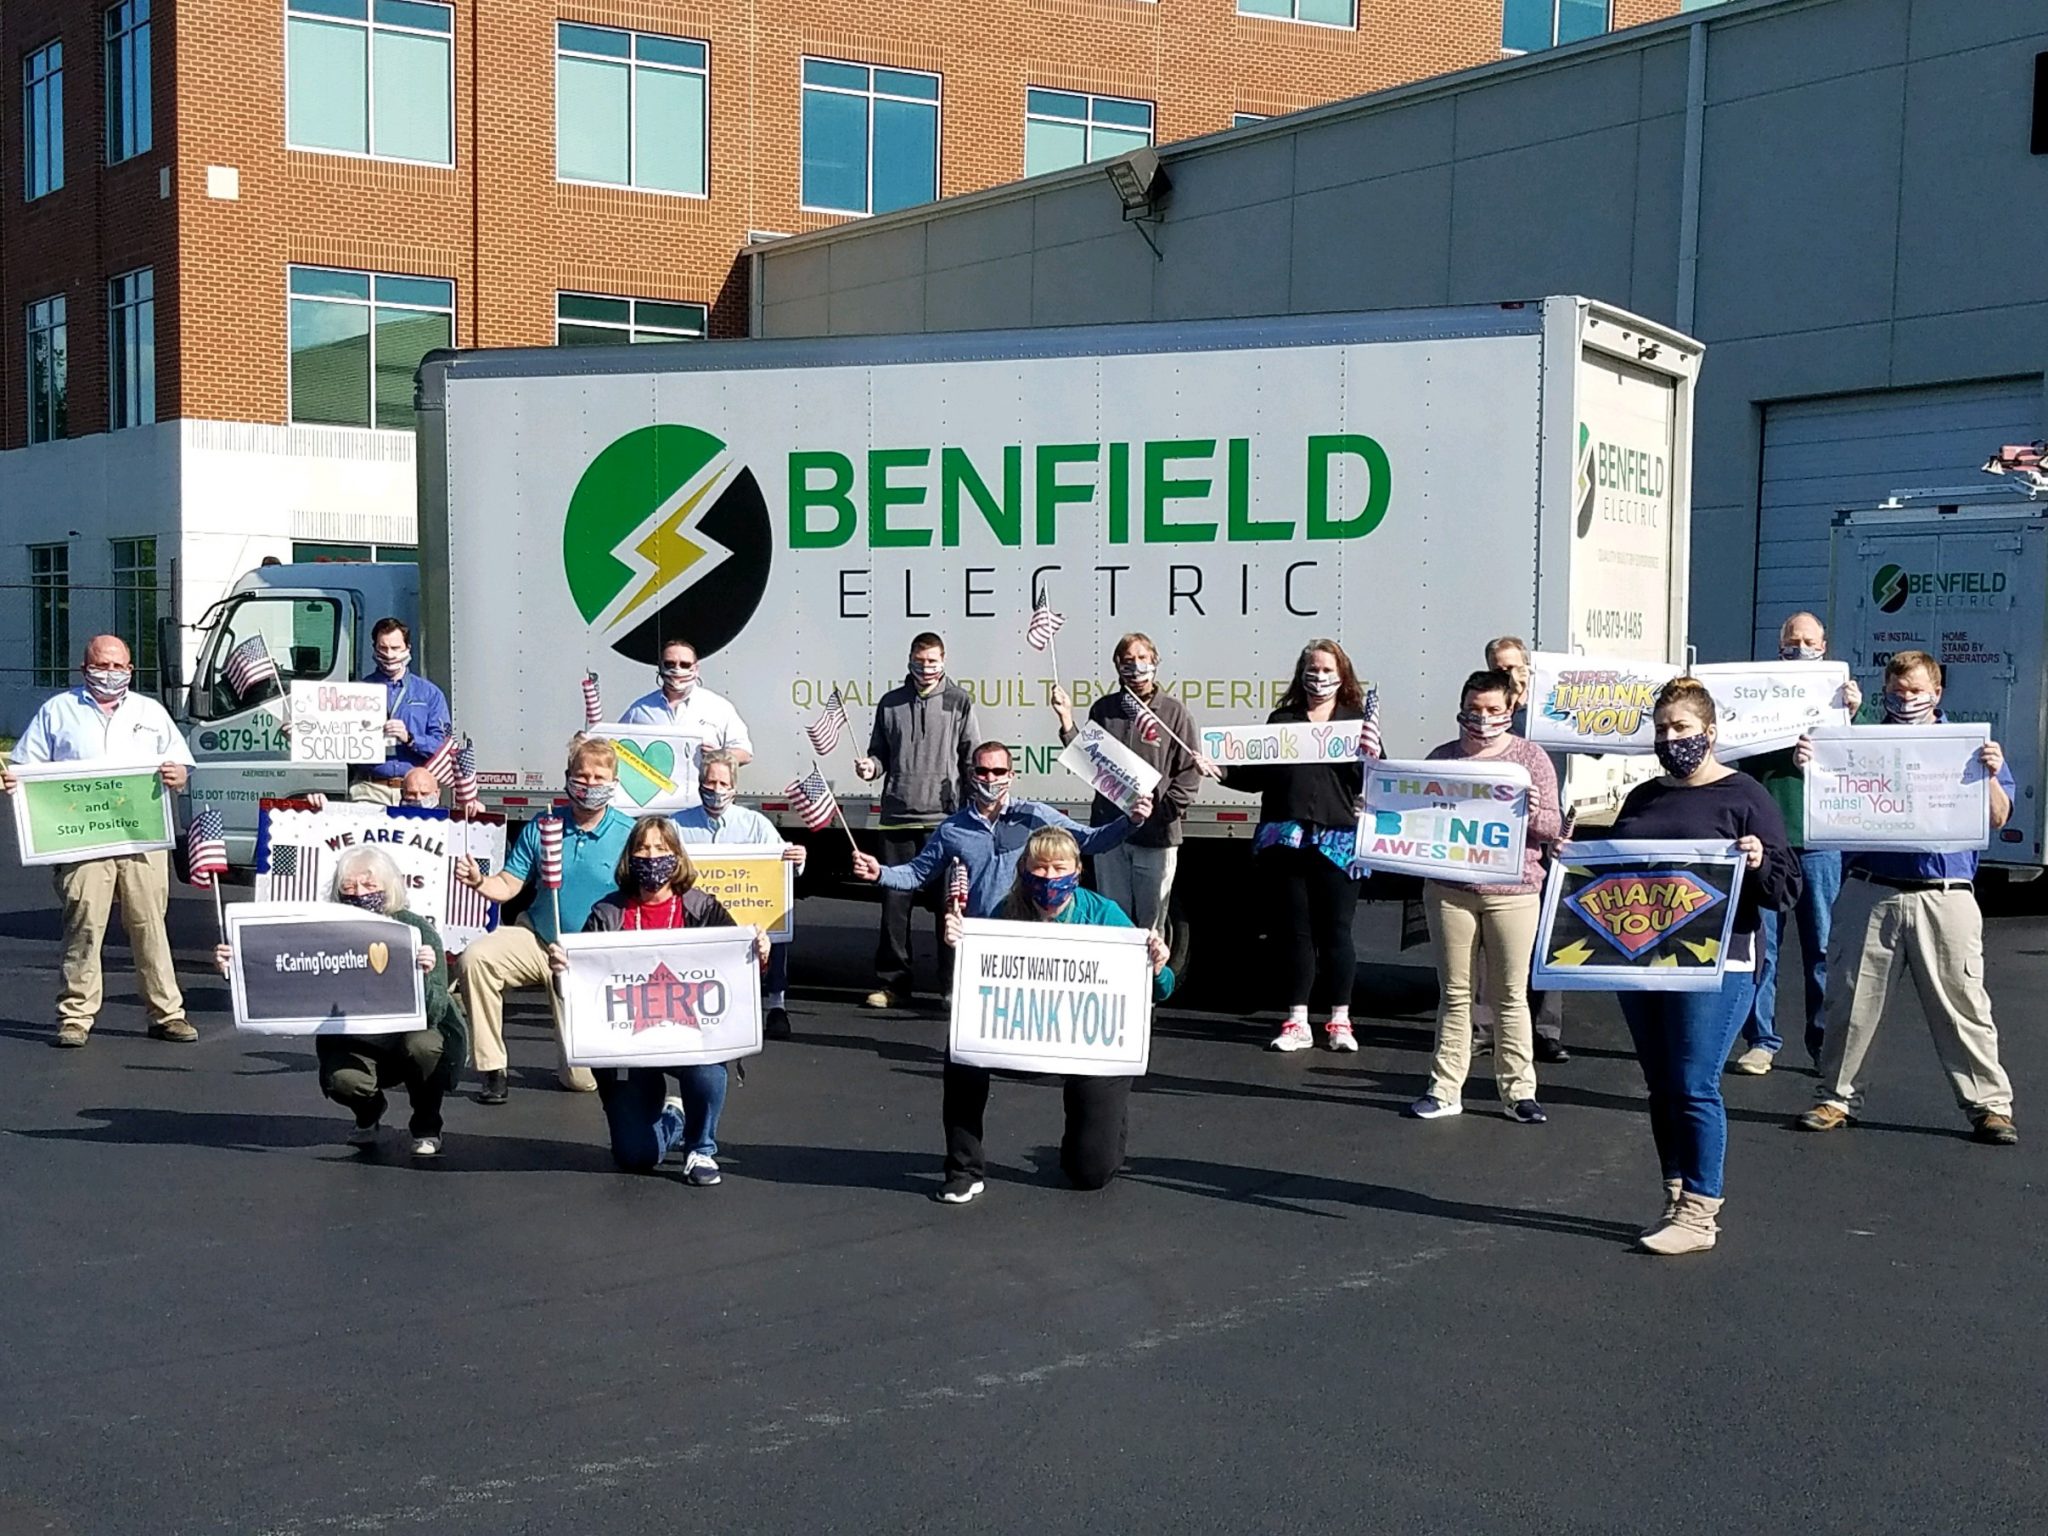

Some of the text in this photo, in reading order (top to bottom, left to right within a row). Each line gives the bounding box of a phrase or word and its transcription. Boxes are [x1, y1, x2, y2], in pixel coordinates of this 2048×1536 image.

[1599, 441, 1664, 498] BENFIELD
[788, 434, 1391, 549] BENFIELD
[1604, 497, 1657, 528] ELECTRIC
[839, 561, 1318, 619] ELECTRIC
[1908, 572, 2006, 594] BENFIELD
[1916, 595, 1996, 607] ELECTRIC
[1586, 608, 1642, 640] 410-879-1485
[1873, 632, 1886, 641] WE
[1942, 632, 1968, 641] HOME
[1942, 642, 1983, 653] STAND BY
[1941, 654, 2000, 664] GENERATORS
[1558, 670, 1621, 684] SUPER
[318, 686, 383, 712] Heroes
[1554, 683, 1656, 710] THANK
[1733, 684, 1806, 701] Stay Safe
[252, 713, 273, 727] 410
[316, 721, 360, 735] wear
[1576, 708, 1642, 736] YOU
[1751, 712, 1780, 723] and
[301, 735, 375, 760] SCRUBS
[1204, 725, 1360, 760] Thank You
[63, 780, 123, 793] Stay Safe
[1377, 778, 1515, 801] THANKS
[1834, 772, 1892, 794] Thank
[85, 801, 110, 812] and
[192, 790, 203, 800] US
[205, 790, 223, 801] DOT
[226, 791, 258, 801] 1072181
[1432, 802, 1457, 811] FOR
[1867, 794, 1904, 814] You
[57, 817, 140, 836] Stay Positive
[1375, 810, 1510, 849] BEING
[325, 828, 445, 858] WE ARE ALL
[1372, 838, 1510, 866] AWESOME
[724, 883, 742, 893] all
[746, 882, 759, 893] in
[1579, 882, 1706, 916] THANK
[1603, 909, 1674, 936] YOU
[275, 949, 369, 976] #CaringTogether
[980, 953, 1109, 985] WE JUST WANT TO SAY...
[611, 969, 716, 984] THANK YOU
[605, 980, 726, 1022] HERO
[978, 985, 1126, 1048] THANK YOU!
